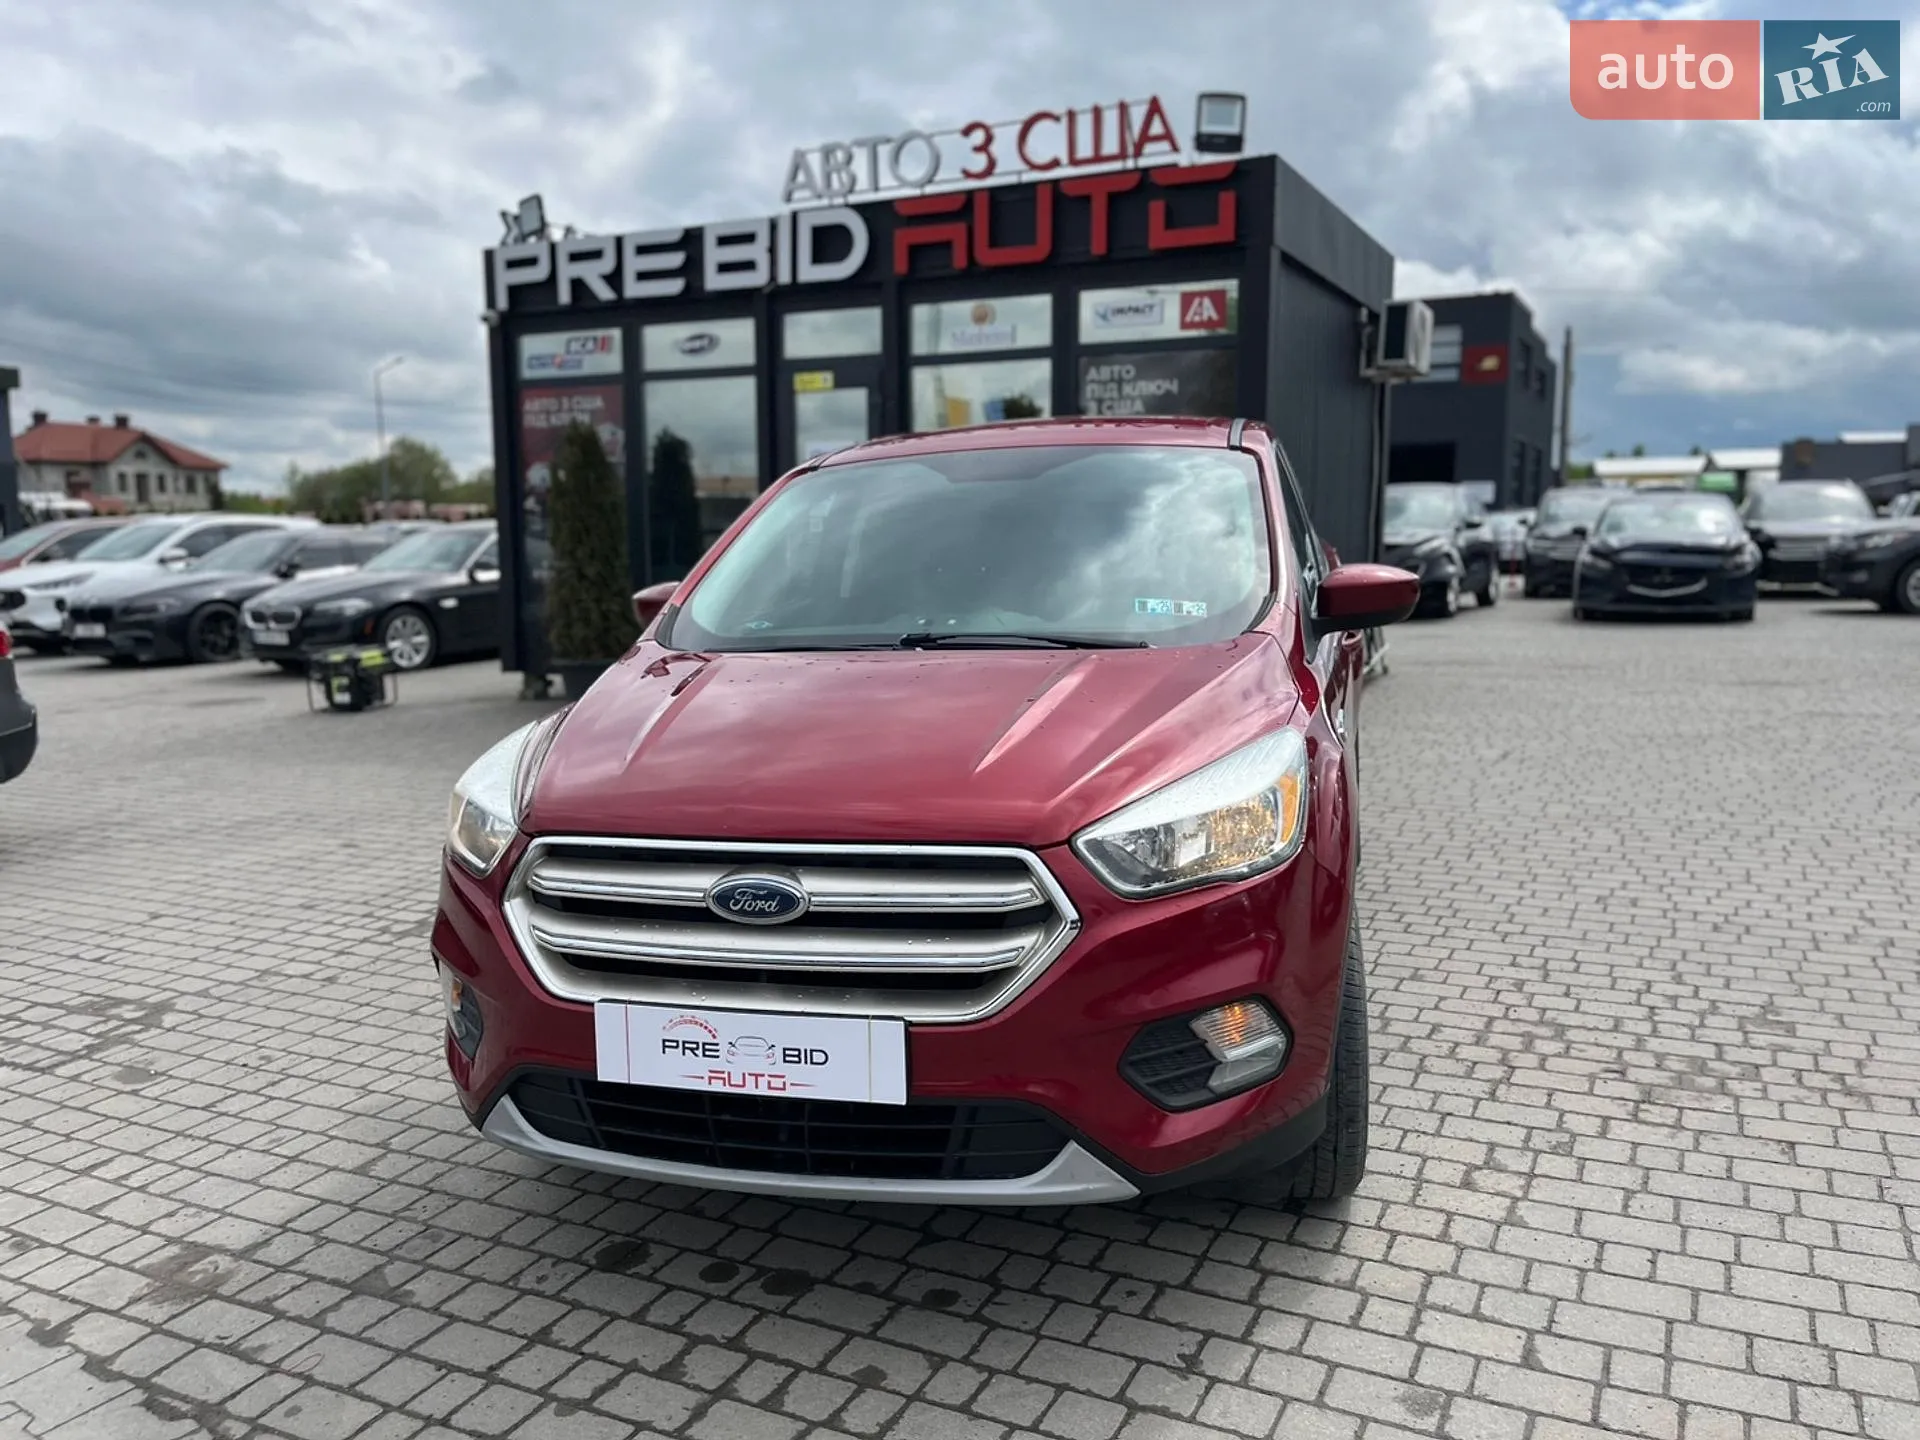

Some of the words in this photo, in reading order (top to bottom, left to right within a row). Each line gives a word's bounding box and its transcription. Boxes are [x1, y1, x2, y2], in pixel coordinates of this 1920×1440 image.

[783, 130, 940, 202] АВТО
[1017, 94, 1179, 171] США
[494, 228, 686, 312] PRE
[703, 207, 869, 293] BID
[893, 160, 1237, 275] AUTO
[729, 888, 781, 912] Ford
[661, 1038, 720, 1060] PRE
[782, 1047, 830, 1066] BID
